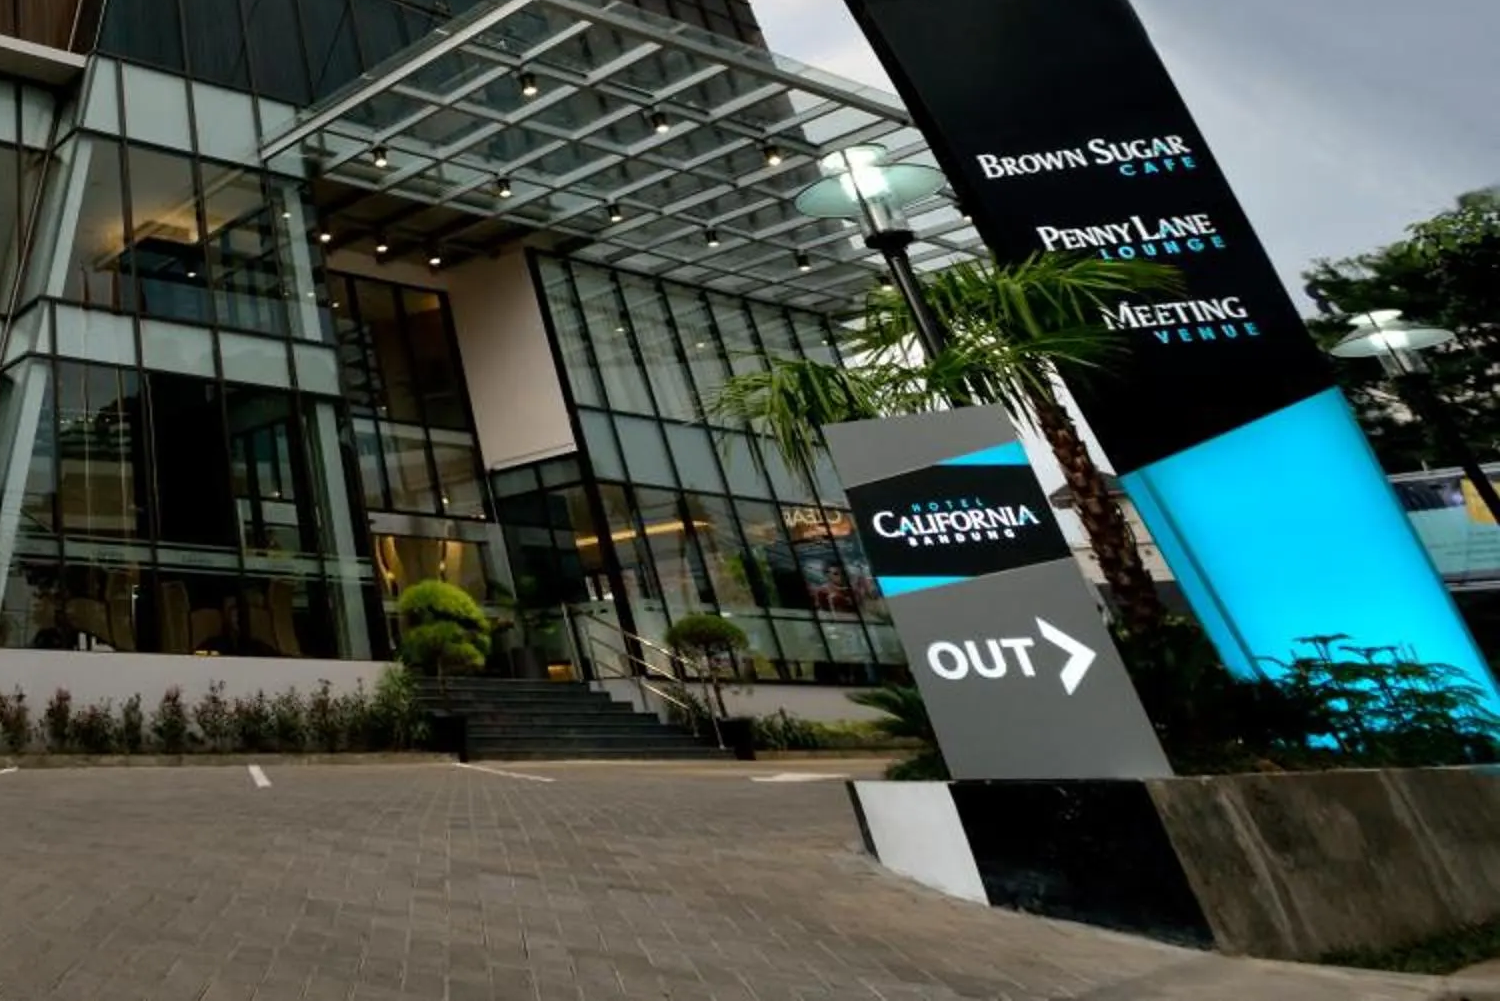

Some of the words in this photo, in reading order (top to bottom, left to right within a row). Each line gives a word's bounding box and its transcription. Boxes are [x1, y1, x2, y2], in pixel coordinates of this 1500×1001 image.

[976, 147, 1088, 179] BROWN
[1088, 134, 1191, 165] SUGAR
[1119, 156, 1197, 176] CAFE
[1100, 235, 1226, 262] LOUNGE
[1101, 297, 1248, 331] MEETING
[1154, 322, 1261, 345] VENUE
[911, 497, 984, 512] HOTEL
[872, 504, 1040, 538] CALIFORNIA
[909, 529, 1015, 547] BANDUNG
[927, 637, 1036, 680] OUT
